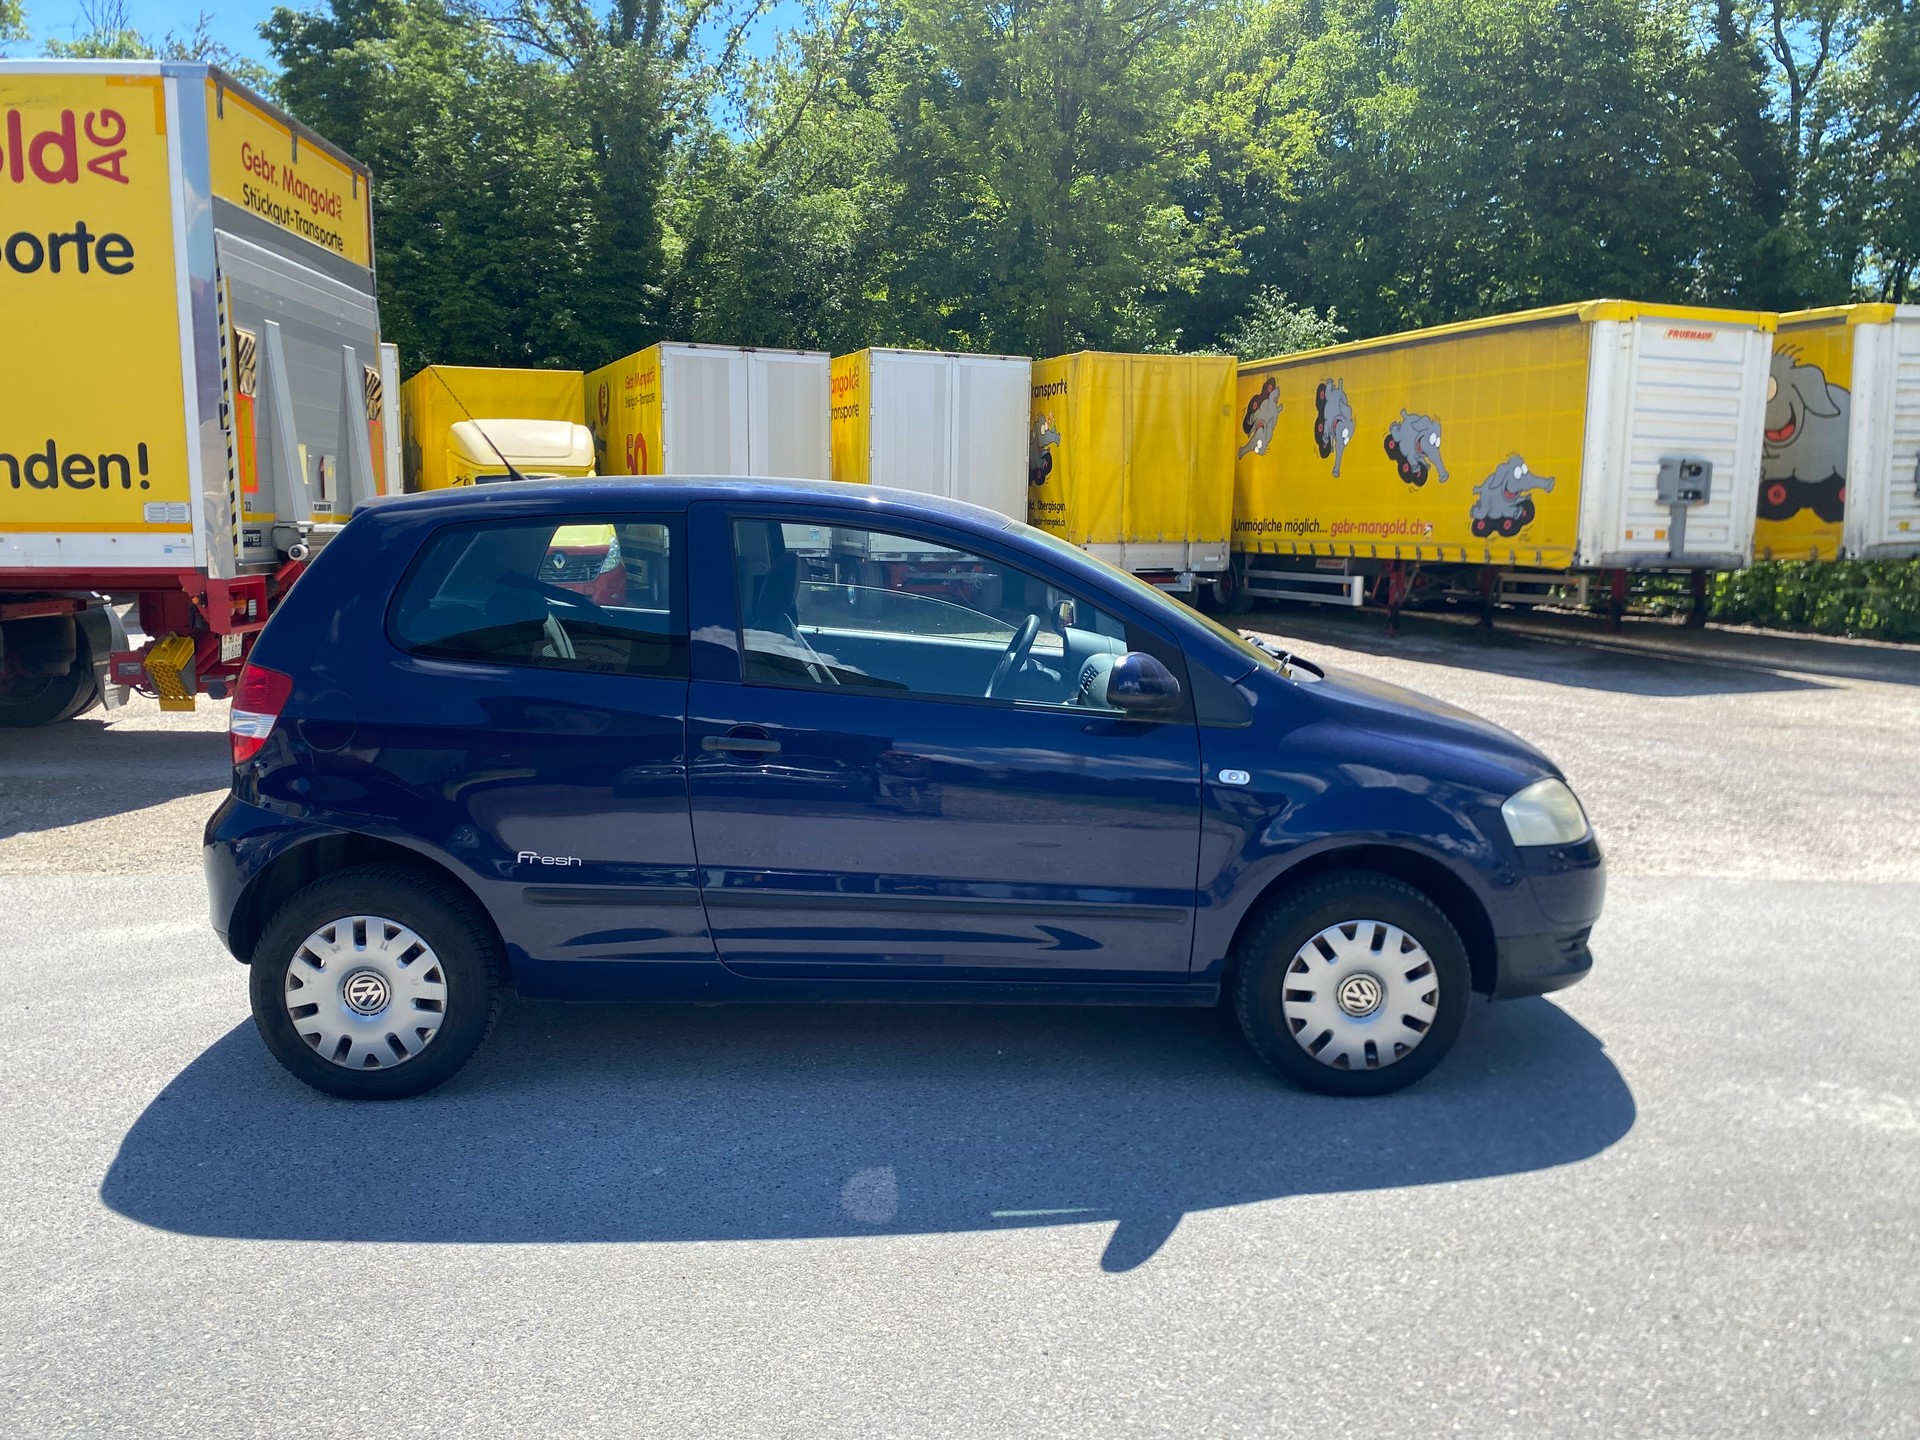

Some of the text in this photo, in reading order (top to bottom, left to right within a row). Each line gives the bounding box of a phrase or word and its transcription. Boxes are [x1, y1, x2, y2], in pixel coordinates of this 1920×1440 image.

[0, 108, 129, 184] ld AG
[241, 141, 343, 221] Gebr. Mangold AG
[242, 182, 344, 252] Stückgut-Transporte
[0, 221, 134, 274] orte
[1667, 329, 1713, 341] FRUEHAUF
[1234, 517, 1282, 535] Unmögliche
[1330, 517, 1424, 539] gebr-mangold.ch
[517, 851, 582, 867] Fresh
